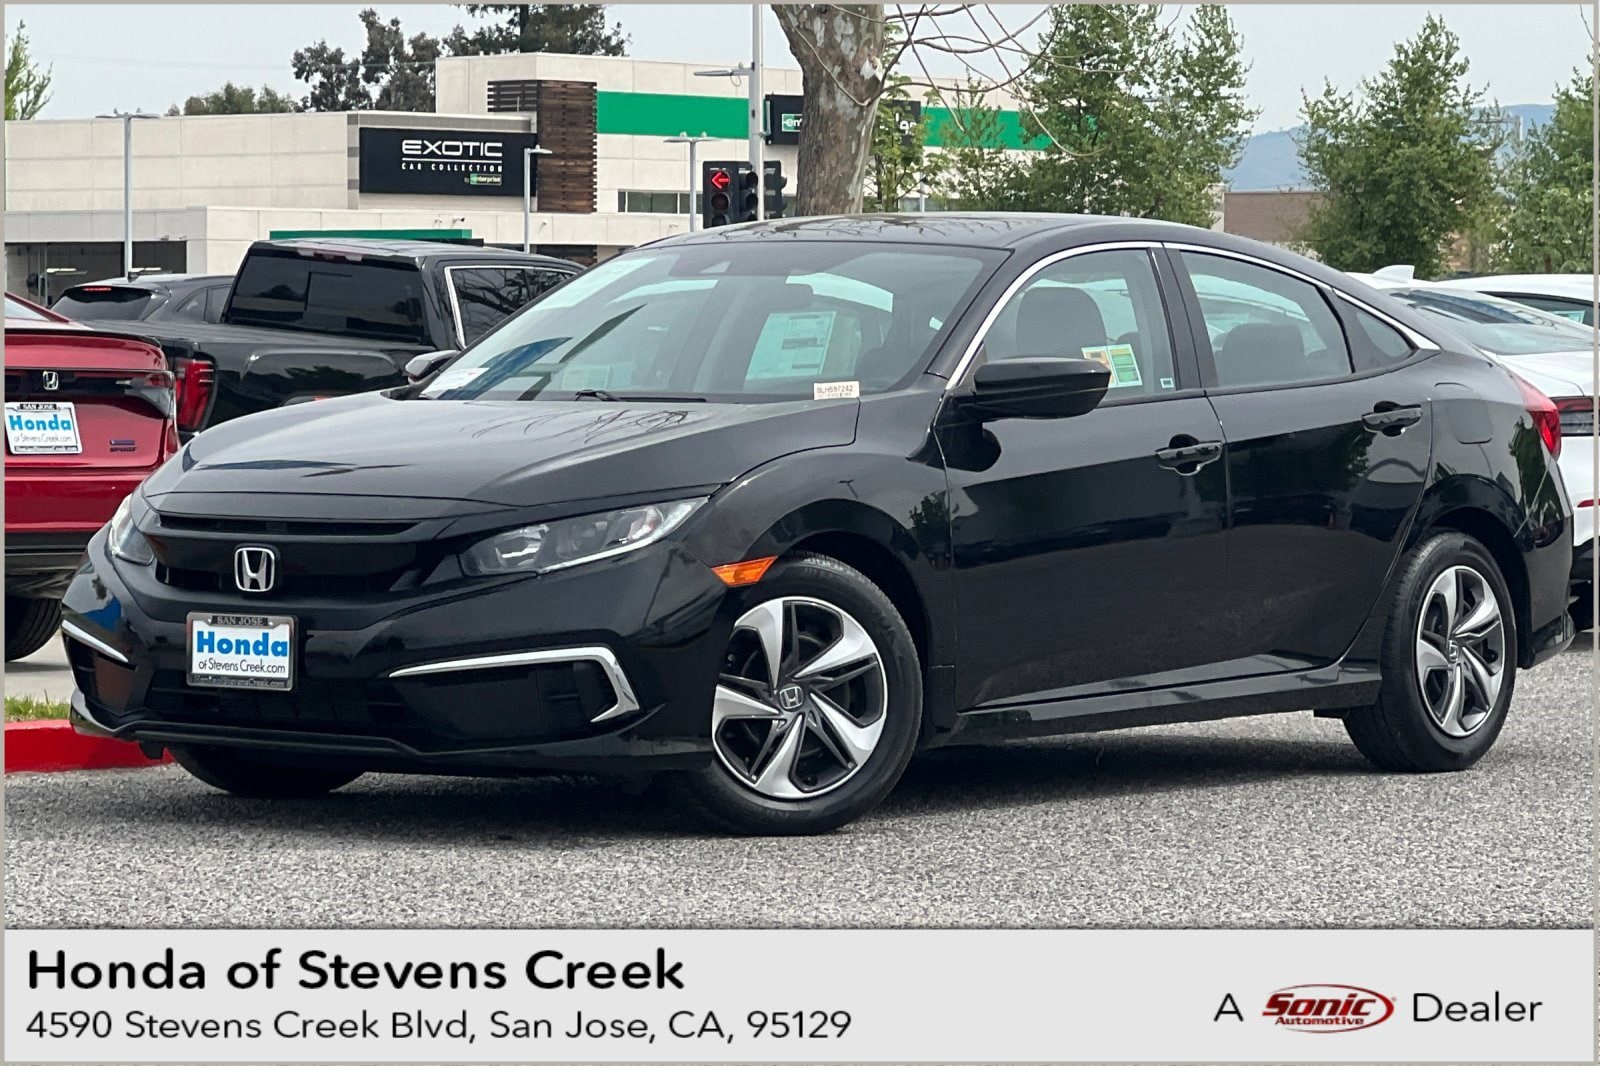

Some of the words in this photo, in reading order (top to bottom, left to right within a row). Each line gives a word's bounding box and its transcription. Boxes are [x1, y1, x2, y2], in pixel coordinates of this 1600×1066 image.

[401, 139, 503, 157] EXOTIC
[401, 163, 422, 171] CAR
[432, 164, 503, 173] COLLECTION
[9, 414, 71, 430] Honda
[217, 616, 237, 625] SAN
[238, 617, 264, 627] JOSE
[197, 631, 288, 657] Honda
[198, 659, 208, 670] of
[208, 657, 239, 672] Stevens
[240, 658, 286, 674] Creek.com
